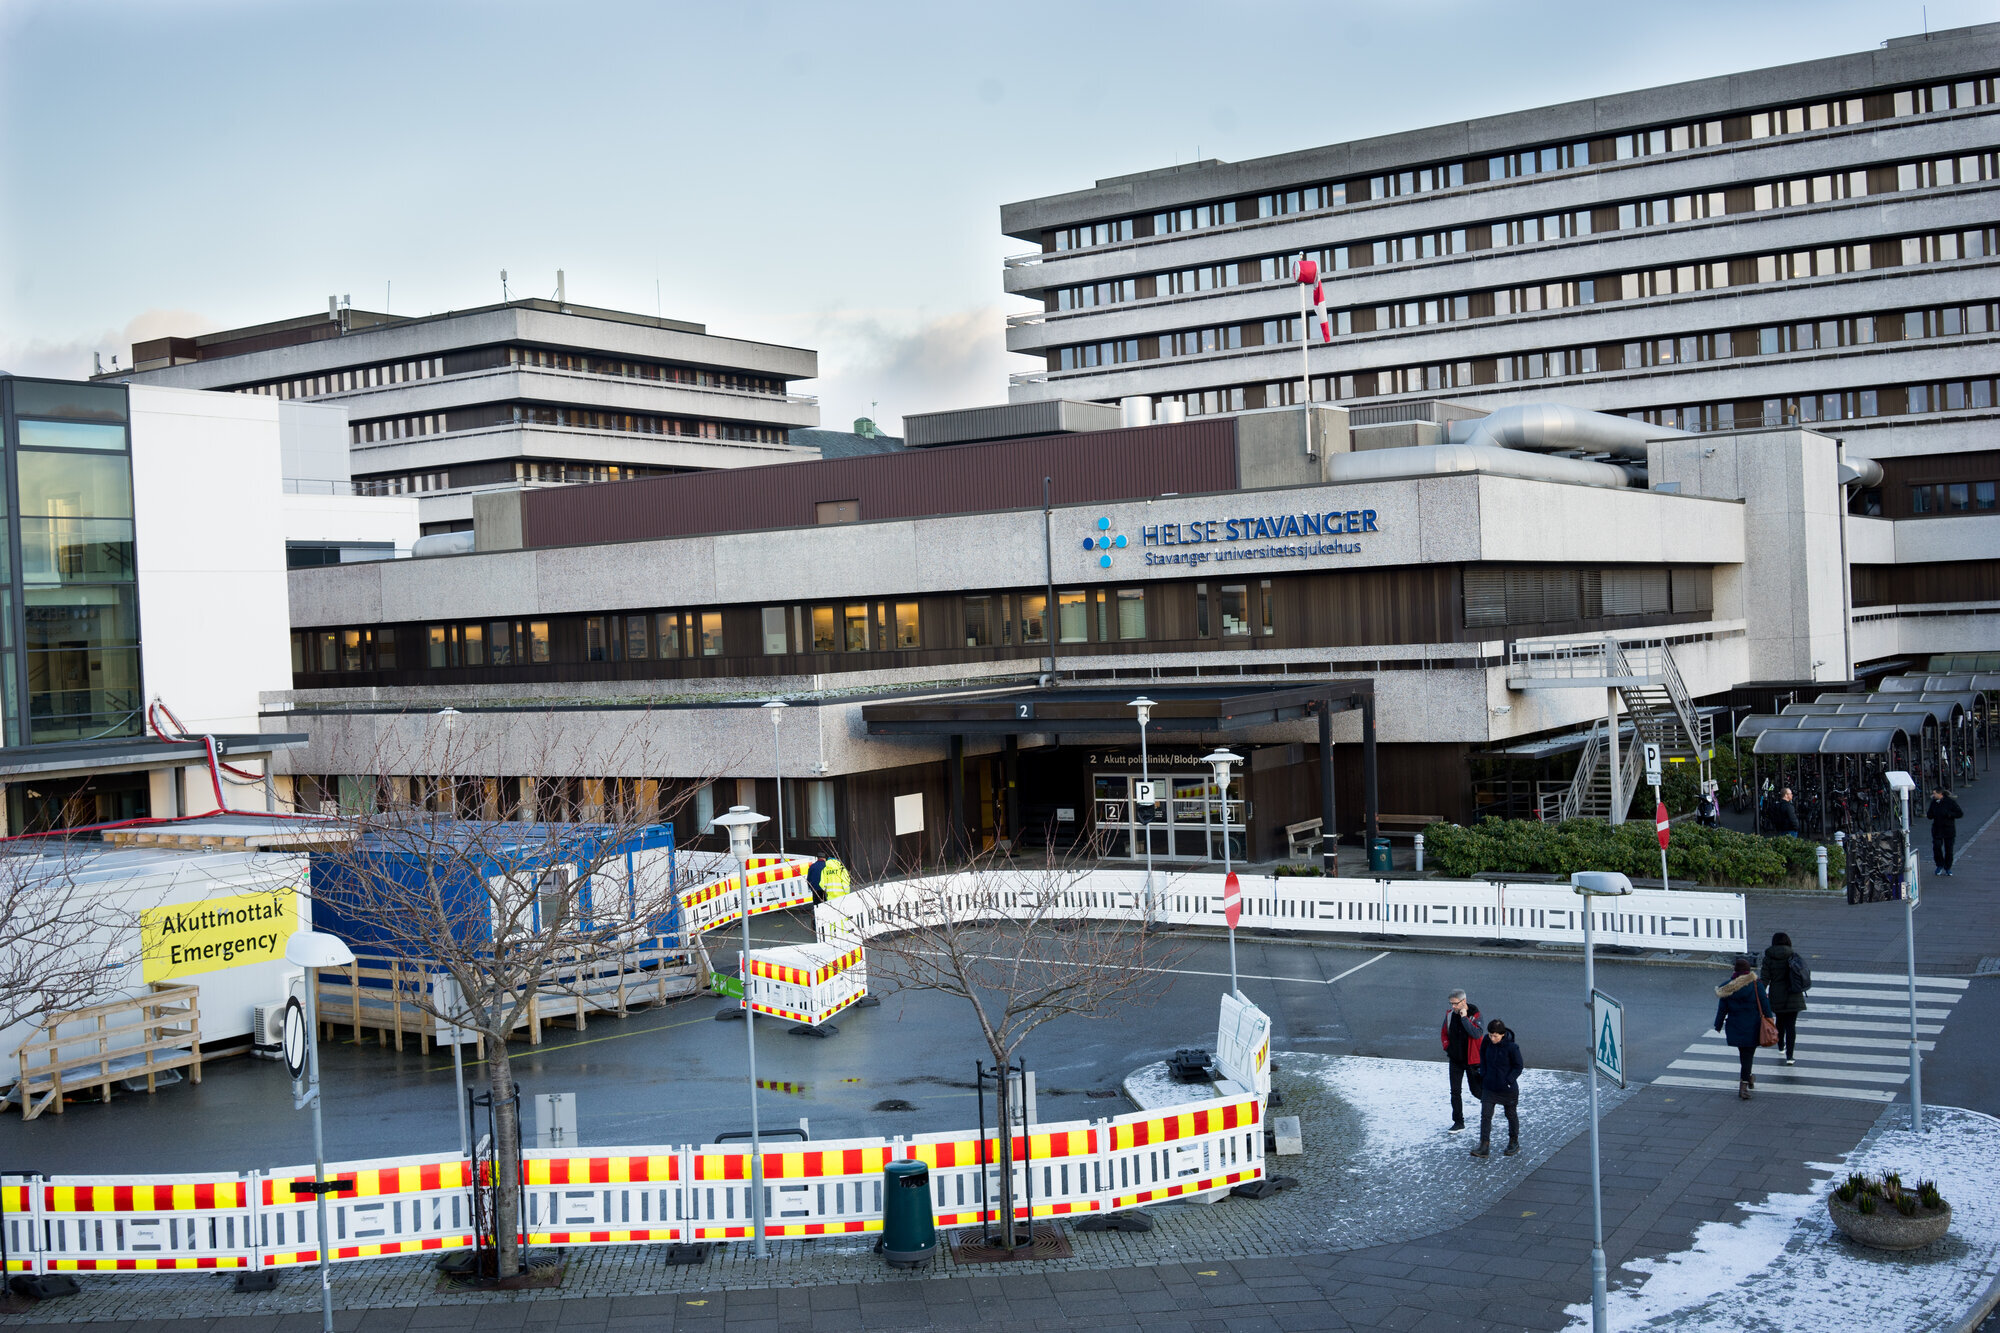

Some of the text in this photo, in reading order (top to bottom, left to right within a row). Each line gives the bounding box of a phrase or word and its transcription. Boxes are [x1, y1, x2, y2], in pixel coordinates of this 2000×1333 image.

[1143, 509, 1379, 546] HELSE STAVANGER
[1145, 539, 1362, 567] Stavanger universitetssjukehus
[1020, 704, 1029, 718] 2
[216, 741, 224, 753] 3
[1090, 754, 1097, 764] 2
[1103, 754, 1127, 764] Akutt
[1647, 747, 1656, 769] P
[1140, 785, 1150, 800] P
[1109, 806, 1117, 818] 2
[162, 897, 283, 936] Akuttmottak
[171, 932, 278, 962] Emergency
